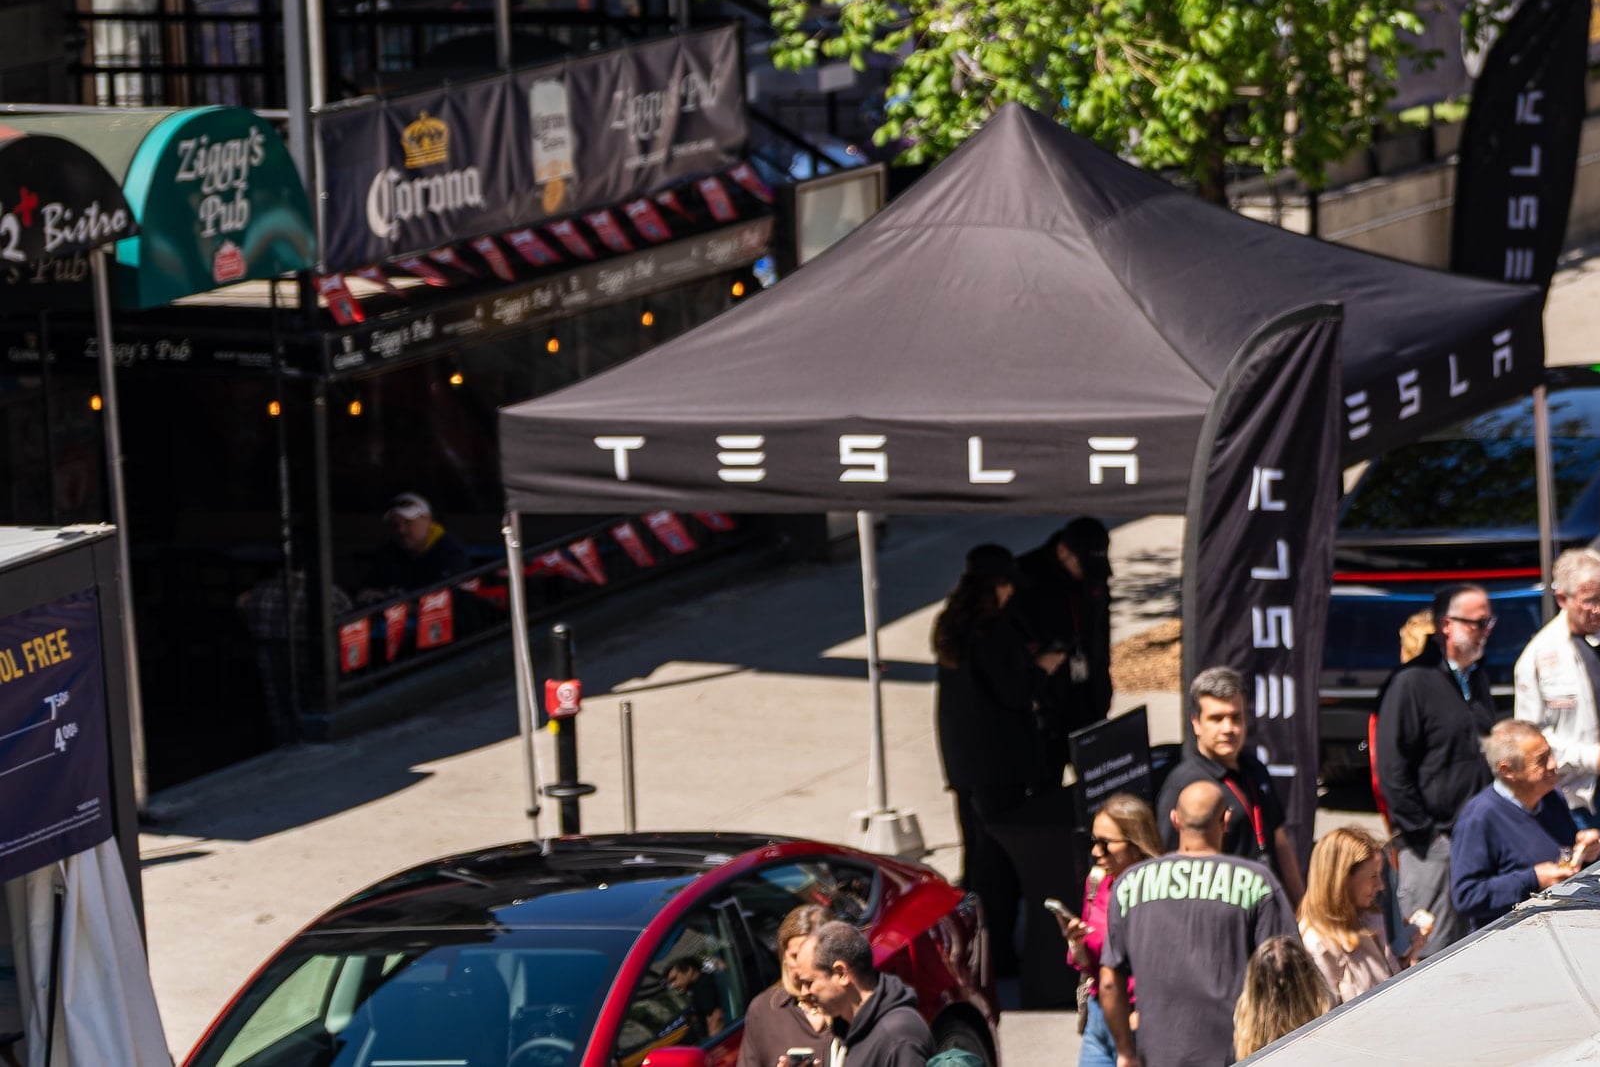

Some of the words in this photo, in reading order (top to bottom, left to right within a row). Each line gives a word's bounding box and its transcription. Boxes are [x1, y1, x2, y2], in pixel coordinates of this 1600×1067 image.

[176, 126, 267, 193] Ziggy's
[1504, 90, 1545, 281] ESLA
[41, 199, 127, 253] Bistro
[200, 190, 250, 238] Pub
[366, 165, 486, 241] Corona
[1344, 328, 1513, 441] ESLA
[593, 434, 1140, 485] TESLA
[21, 627, 73, 674] FREE
[1116, 858, 1273, 919] GYMSHARK
